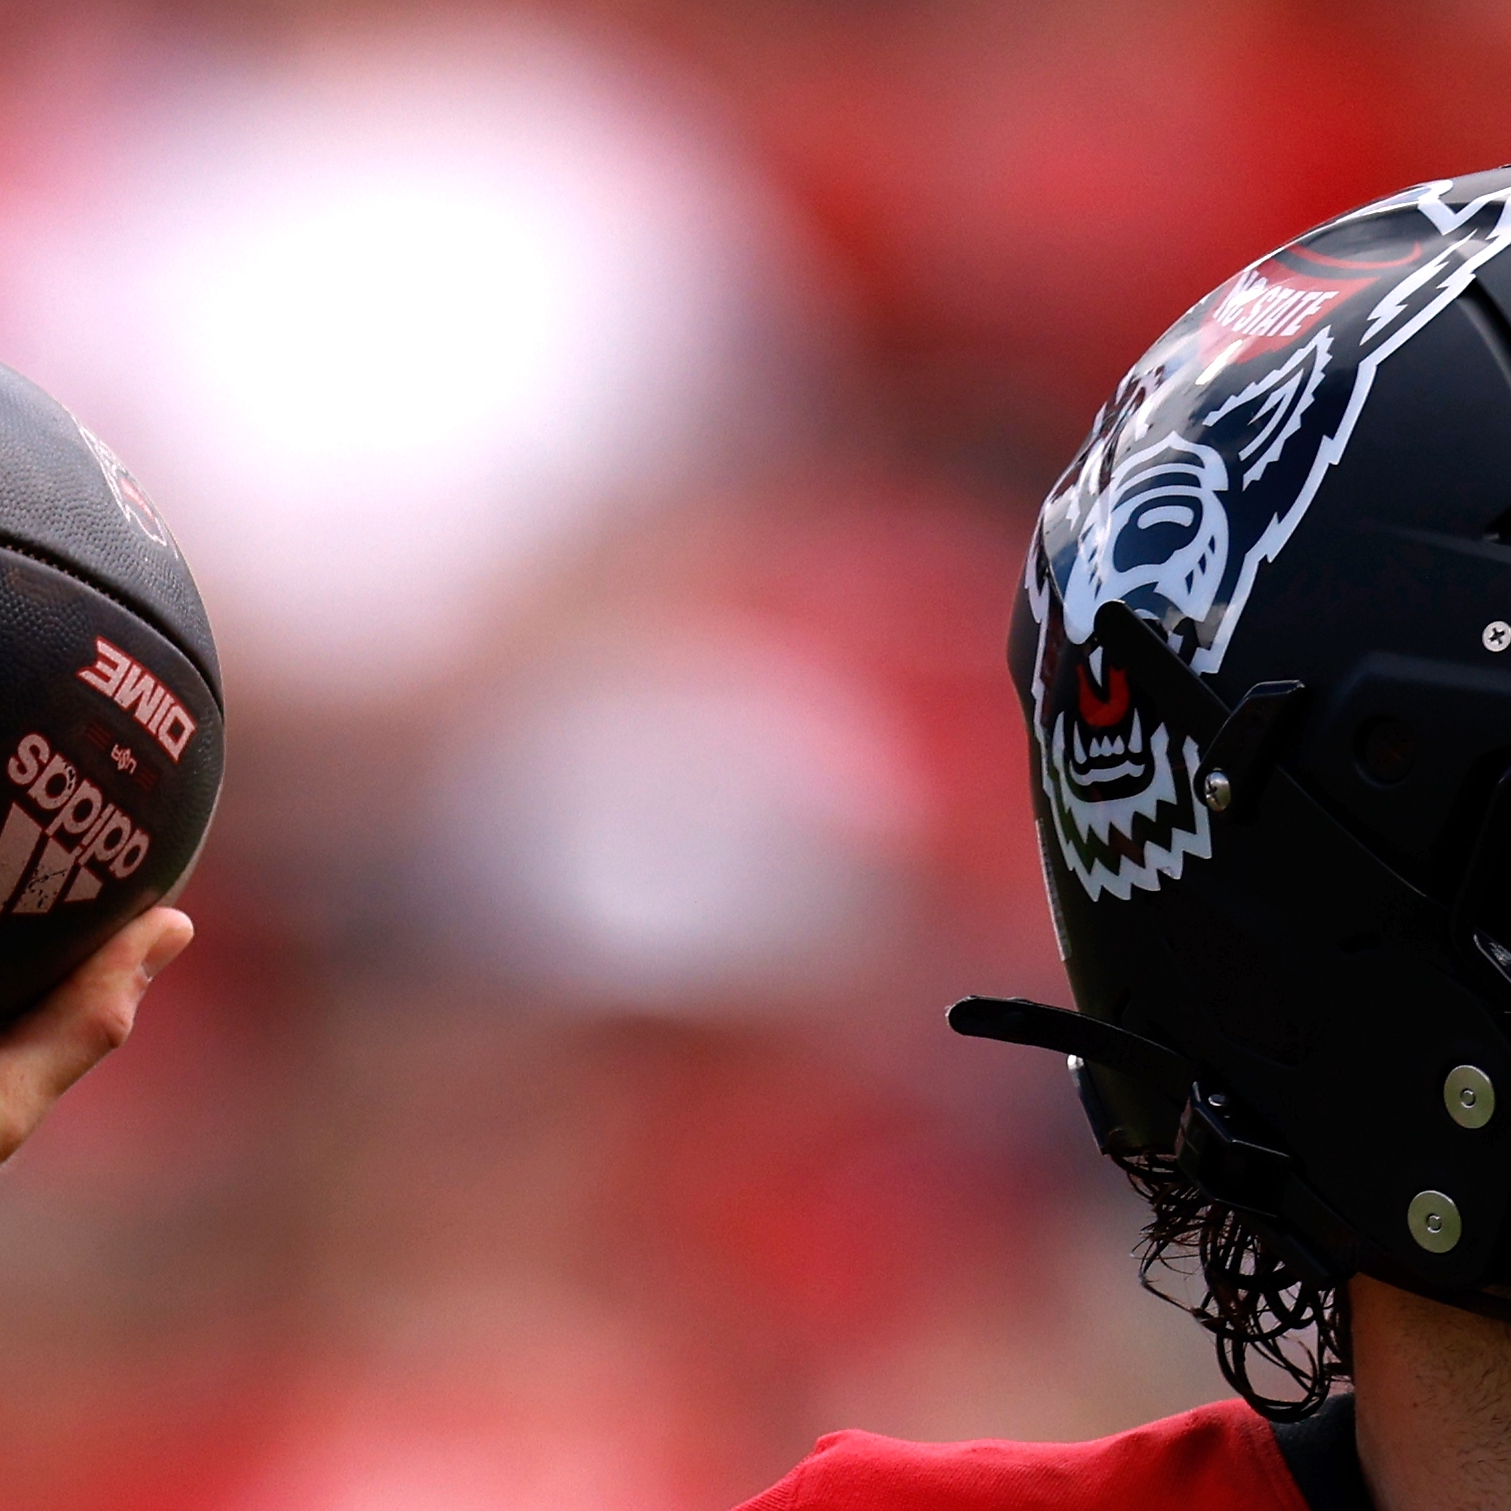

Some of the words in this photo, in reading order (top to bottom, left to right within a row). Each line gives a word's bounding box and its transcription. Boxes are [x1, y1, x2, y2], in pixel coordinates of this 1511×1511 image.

[1232, 286, 1339, 338] STATE
[77, 636, 197, 763] DIME
[7, 733, 150, 879] adidas
